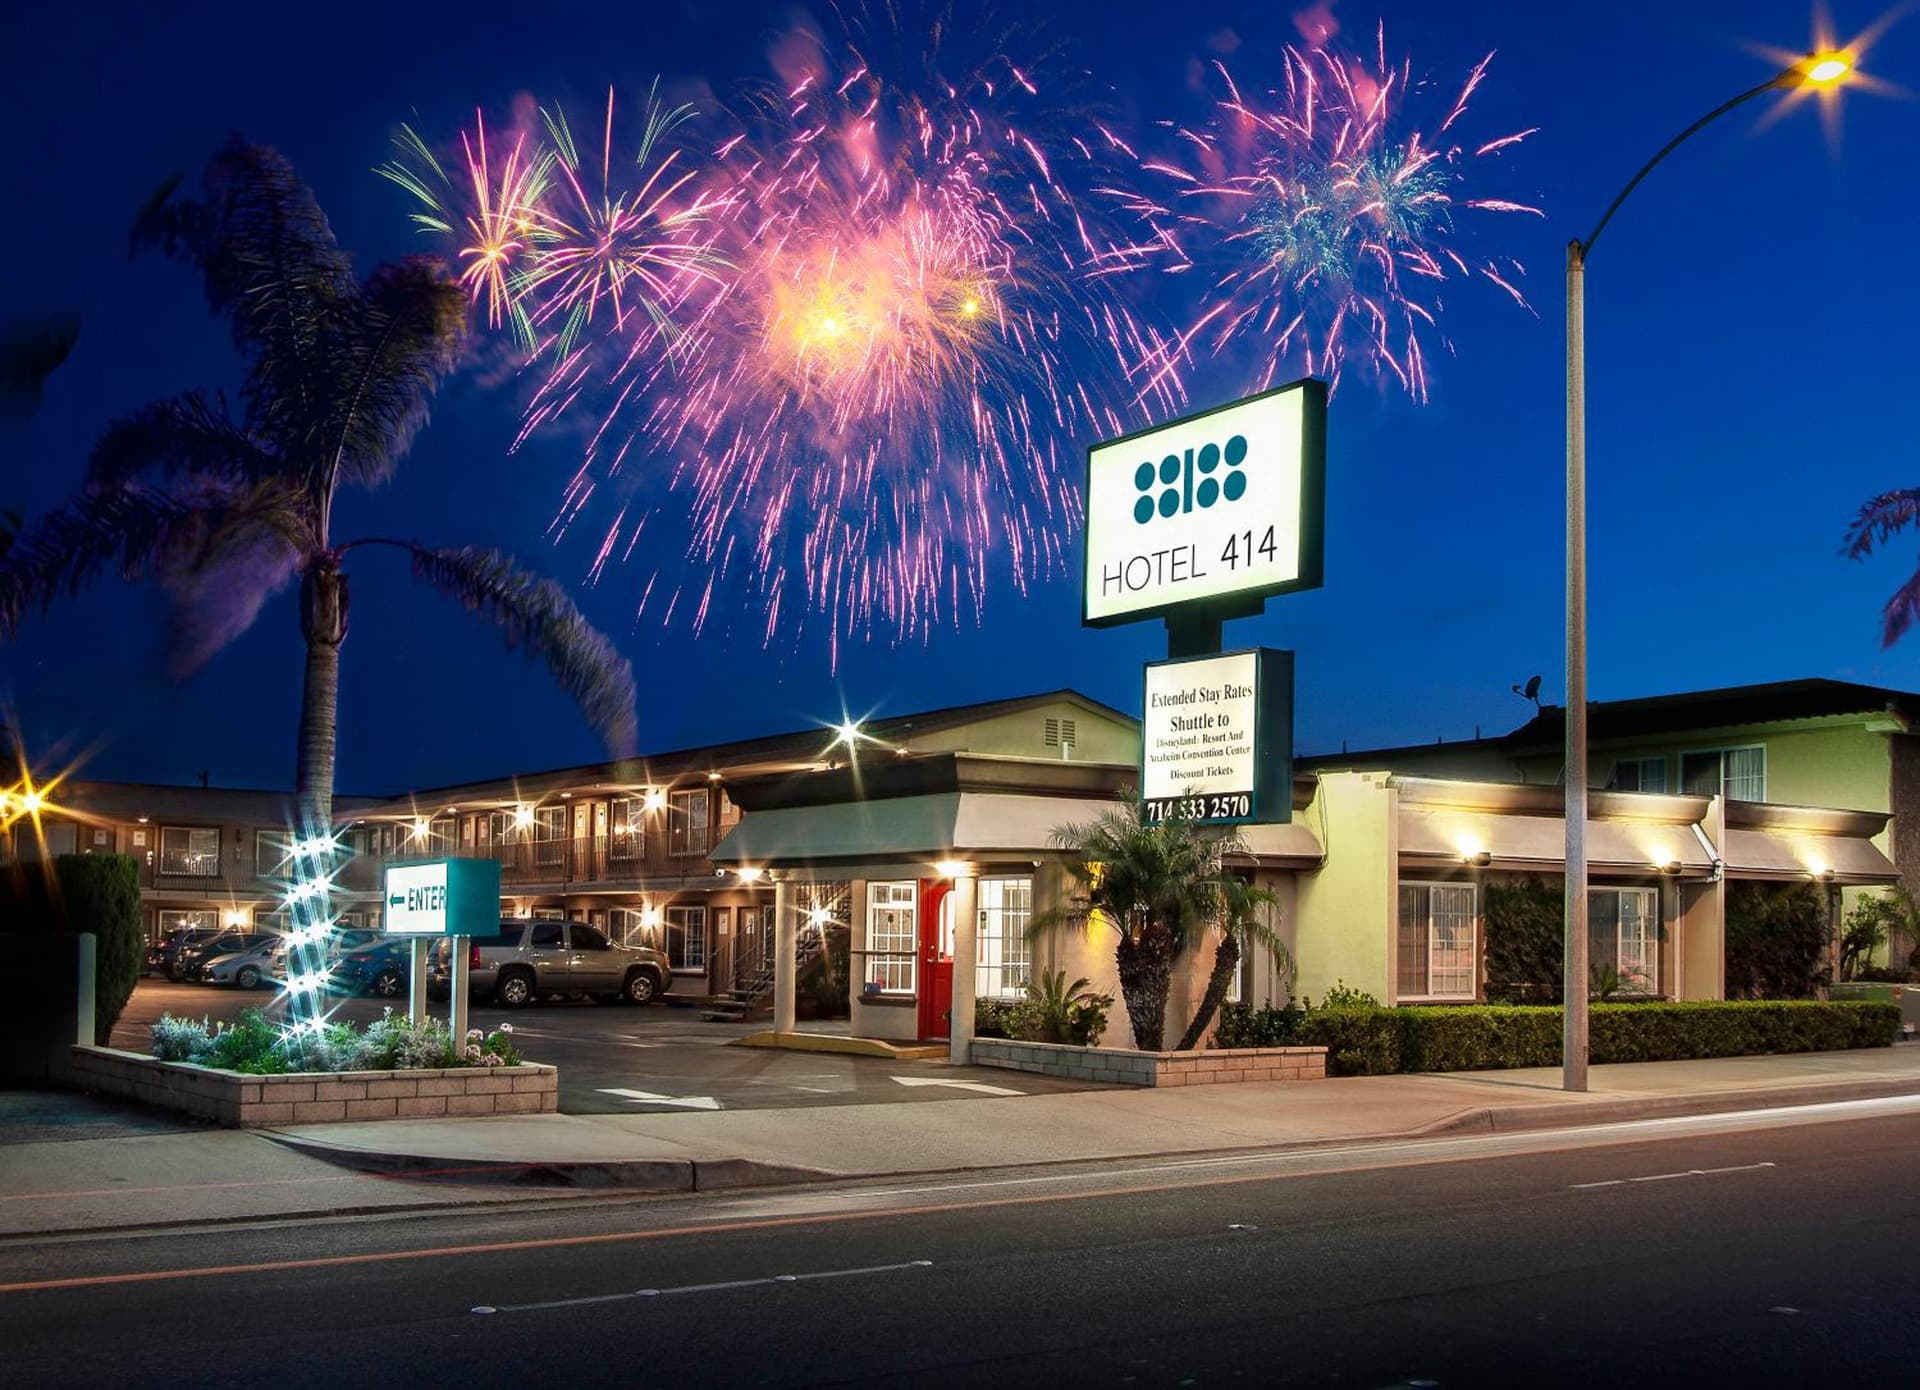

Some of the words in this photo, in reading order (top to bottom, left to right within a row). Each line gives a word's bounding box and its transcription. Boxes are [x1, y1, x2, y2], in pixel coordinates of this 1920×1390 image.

[1103, 544, 1206, 596] HOTEL
[1221, 525, 1278, 570] 414
[1152, 688, 1196, 708] Extended
[1199, 687, 1221, 704] Stay
[1224, 684, 1253, 700] Rates
[1170, 713, 1214, 732] Shuttle
[1217, 713, 1230, 727] to
[1202, 733, 1226, 744] Resort
[1228, 730, 1244, 741] And
[1182, 747, 1223, 760] Convention
[1225, 745, 1251, 756] Center
[1170, 768, 1204, 779] Discount
[1206, 766, 1234, 777] Tickets
[1147, 800, 1173, 822] 714
[1211, 795, 1249, 818] 2570
[408, 885, 447, 911] ENTER
